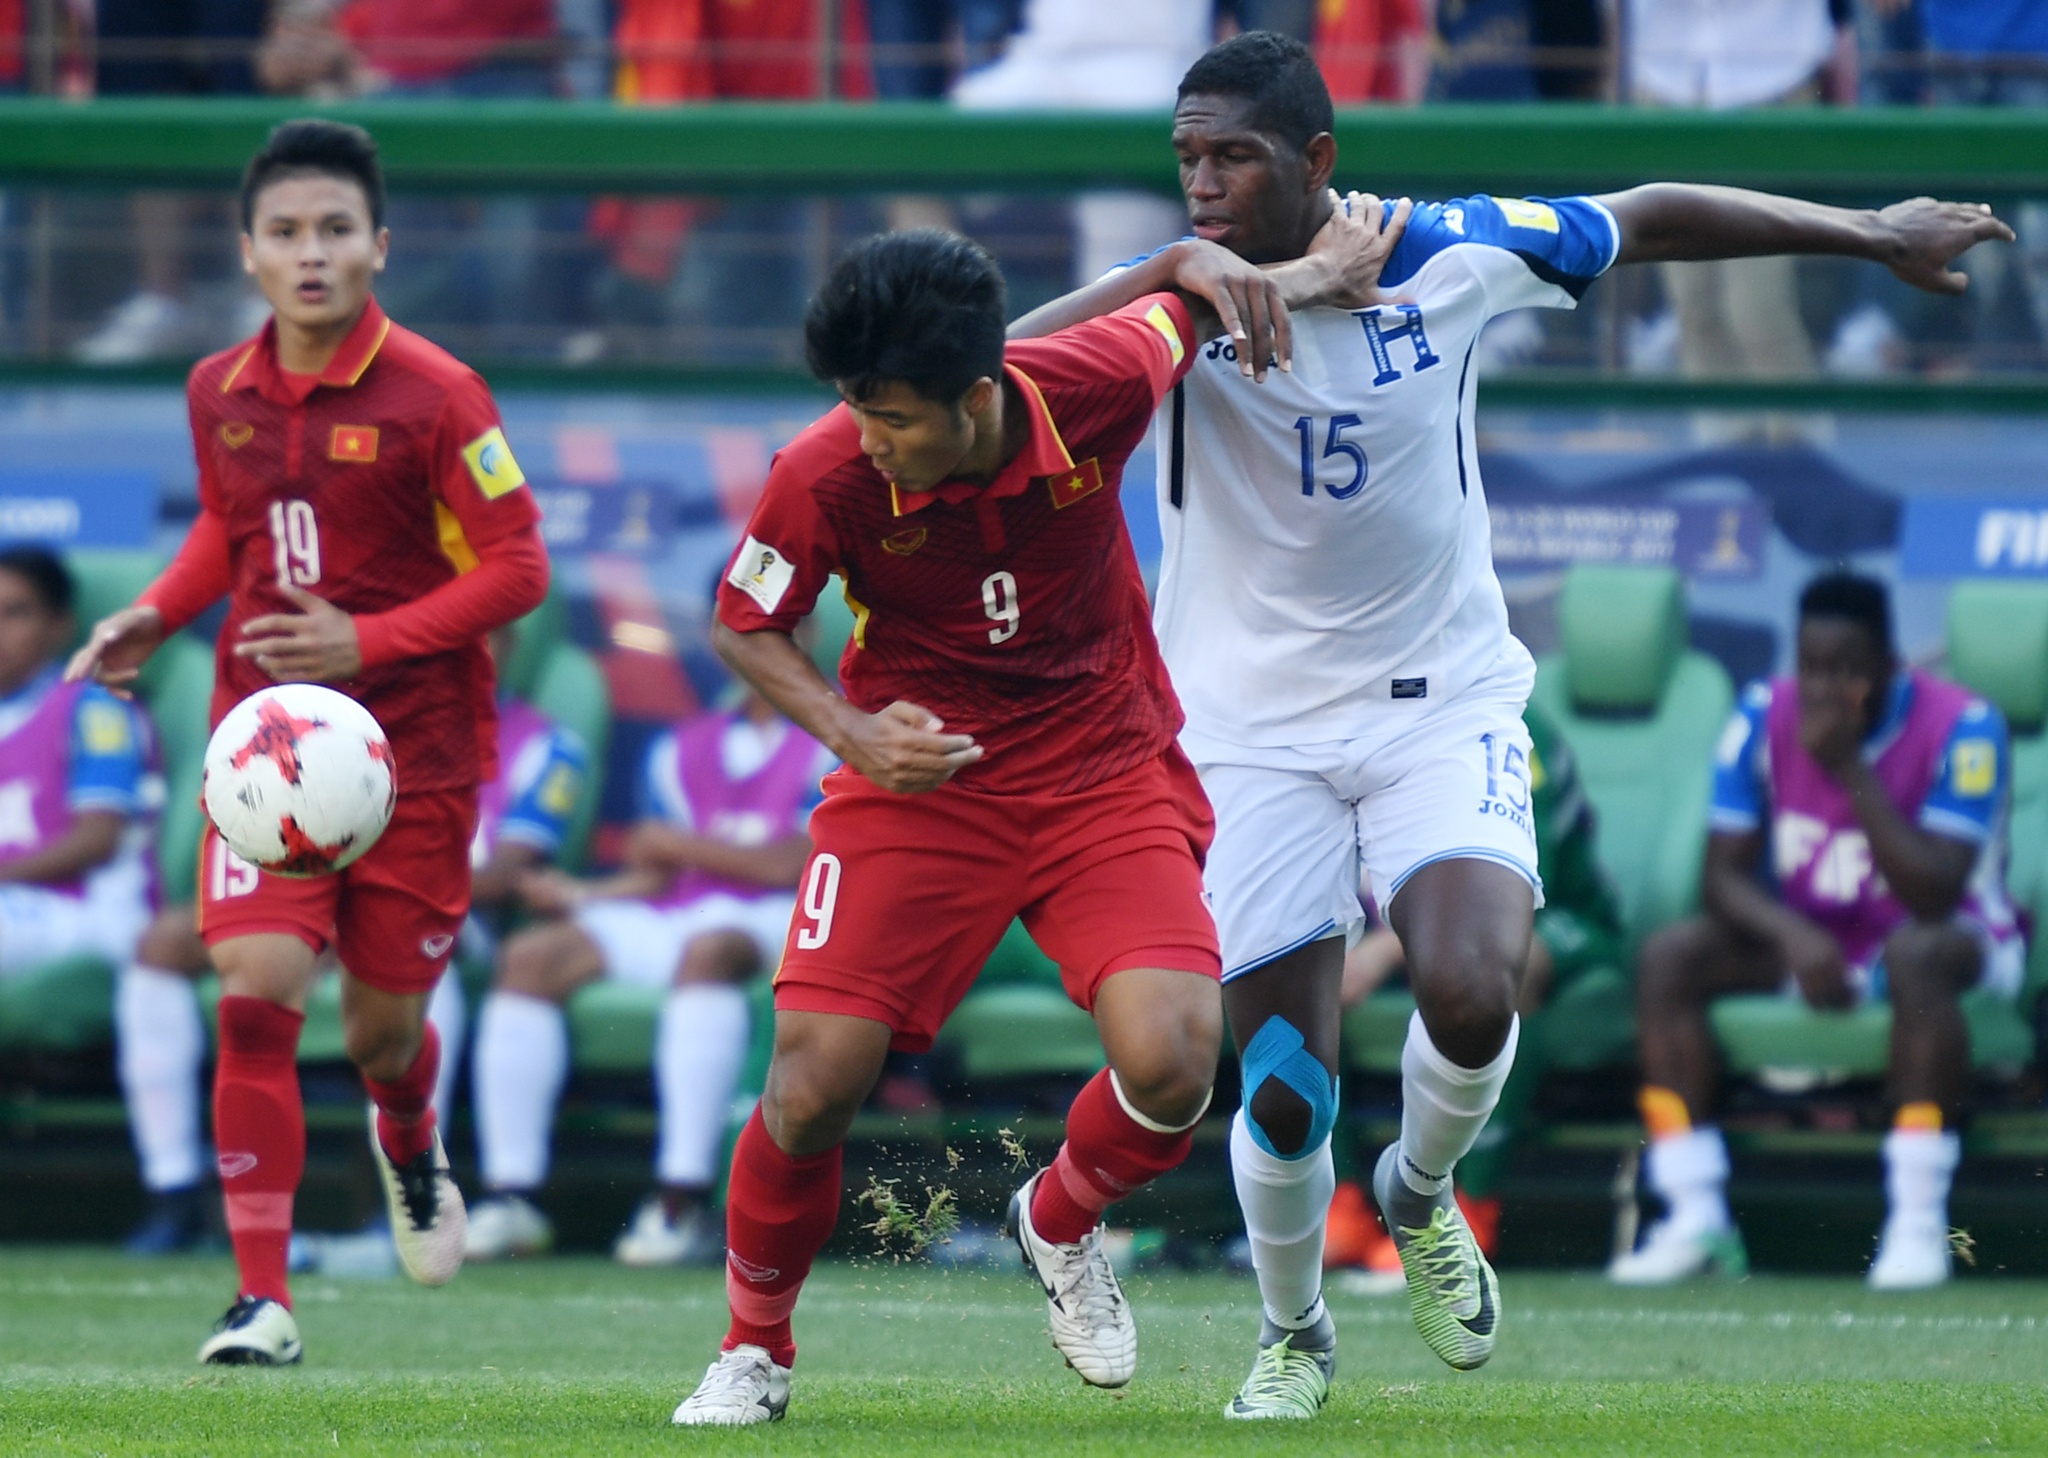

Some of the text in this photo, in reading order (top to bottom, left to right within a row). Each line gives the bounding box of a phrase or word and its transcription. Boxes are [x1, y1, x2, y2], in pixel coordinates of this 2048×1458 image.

[1293, 413, 1368, 500] 15
[270, 500, 322, 586] 19
[1977, 509, 2048, 567] FI
[981, 570, 1020, 645] 9
[1479, 733, 1528, 812] 15
[1773, 812, 1889, 903] FIF
[797, 852, 842, 950] 9
